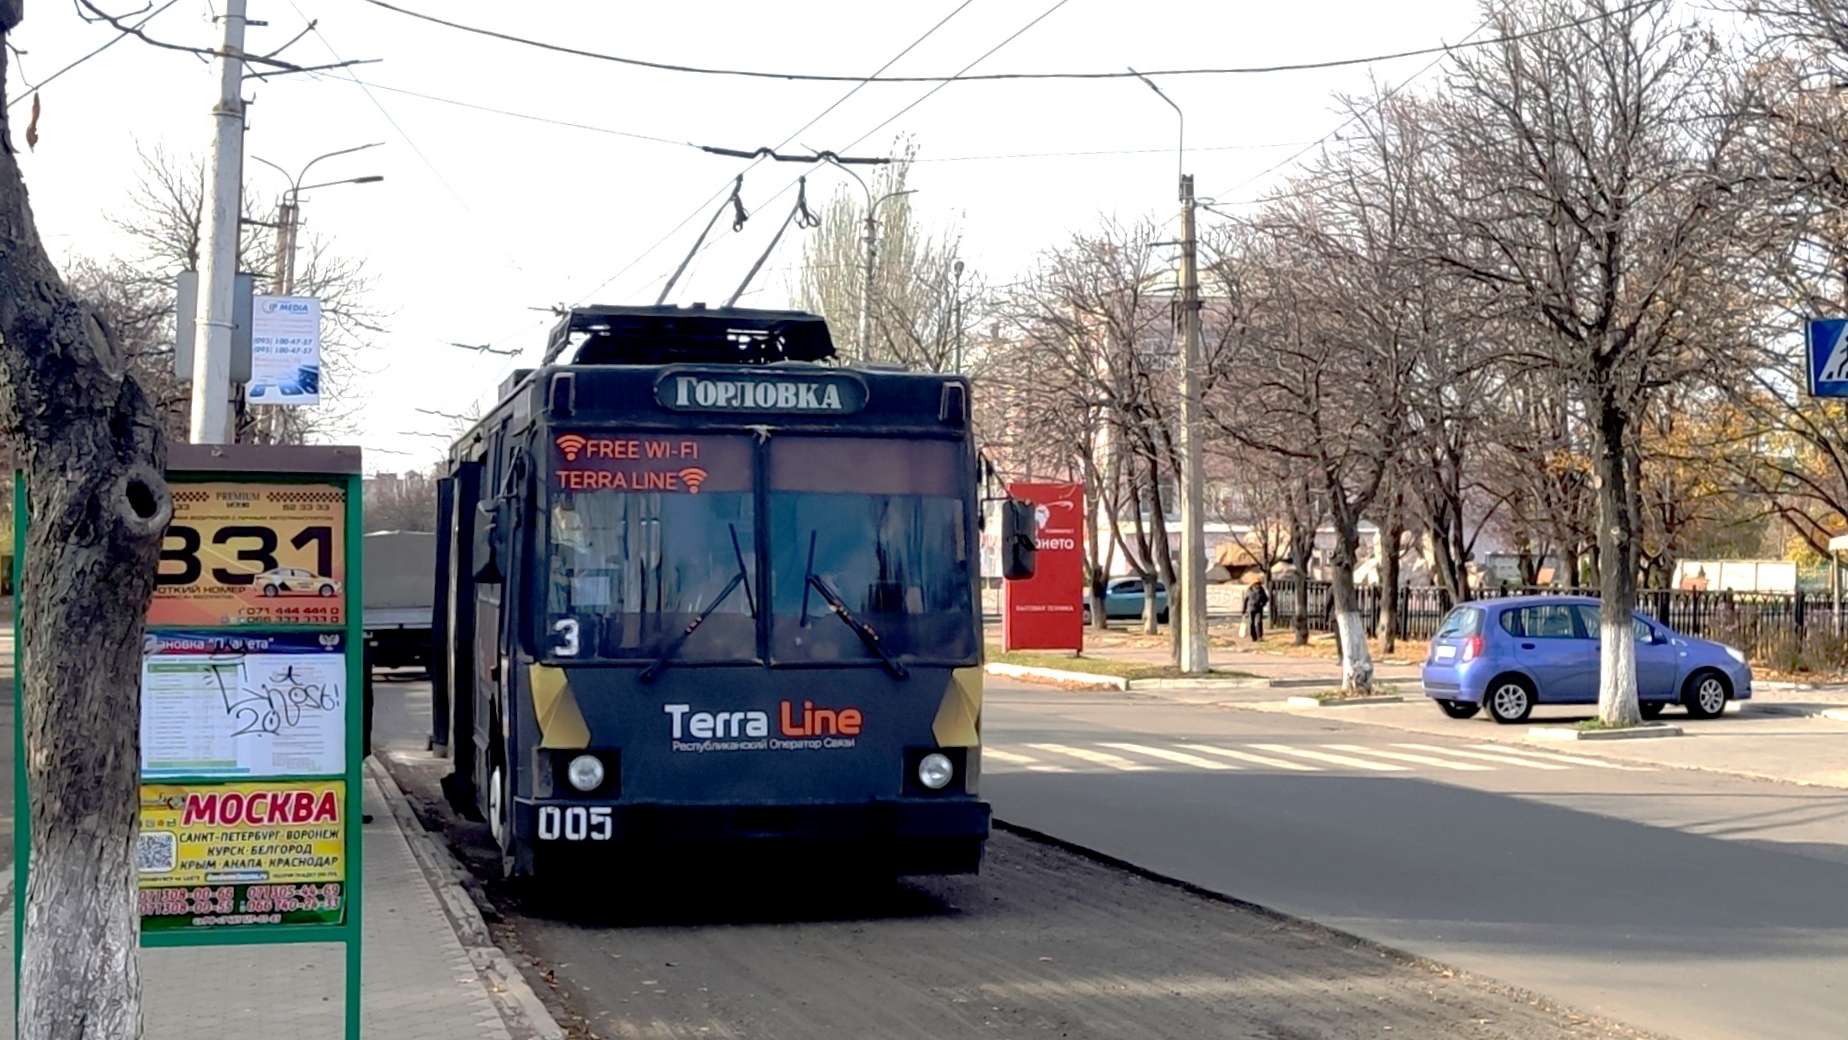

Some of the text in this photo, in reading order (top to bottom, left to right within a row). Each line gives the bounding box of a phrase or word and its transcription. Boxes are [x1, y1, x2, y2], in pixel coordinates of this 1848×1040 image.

[675, 376, 843, 410] ГОРЛОВКА
[585, 440, 699, 459] FREE WI-FI
[555, 470, 678, 490] TERRA LINE
[216, 492, 261, 501] PREMIUM
[157, 585, 201, 594] ОТКИЙ
[555, 619, 579, 656] 3
[664, 701, 862, 738] Terra Line
[672, 737, 855, 753] Республиканский Оператор Связи
[182, 791, 338, 826] МОСКВА
[538, 806, 612, 841] 005
[179, 829, 339, 843] САНКТ-ПЕТЕРБУРГ ВОРОНЕЖ
[207, 844, 313, 856] КУРСК БЕЛГОРОД
[180, 857, 339, 870] КРЫМ АНАПА КРАСНОДАР
